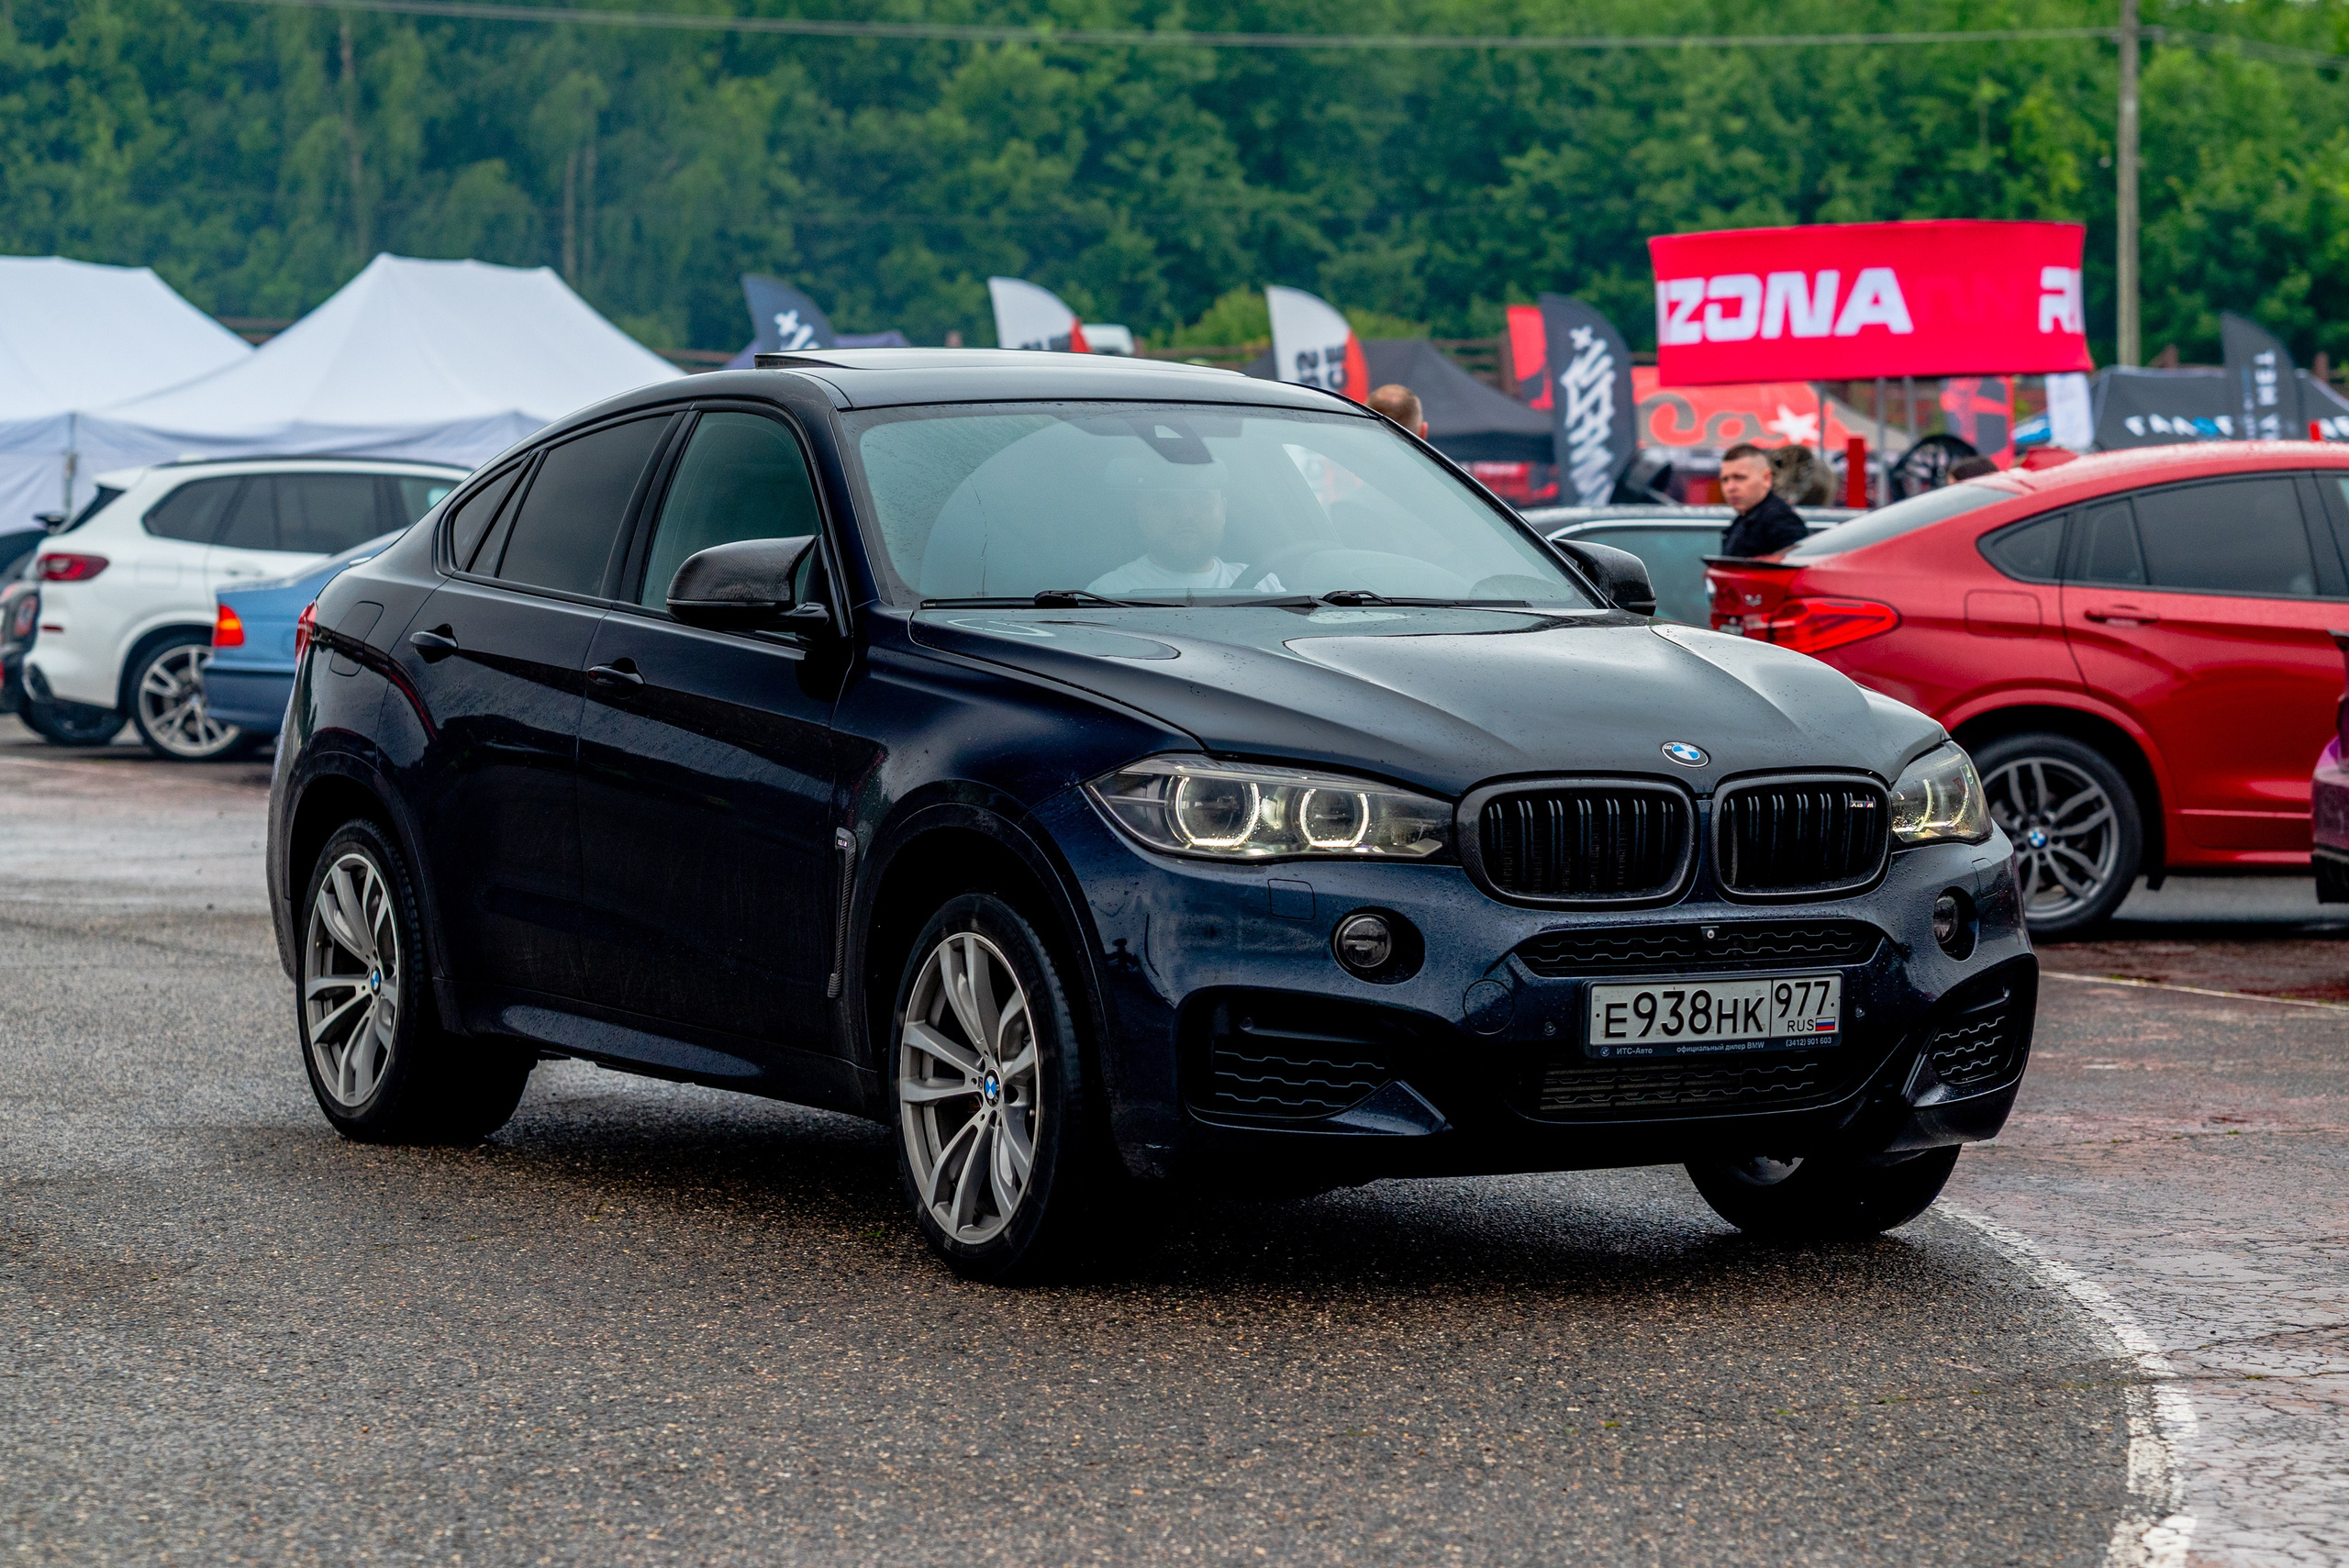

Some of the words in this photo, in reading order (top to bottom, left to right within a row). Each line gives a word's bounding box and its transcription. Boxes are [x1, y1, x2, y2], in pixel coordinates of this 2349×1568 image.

[1656, 267, 1914, 346] ZONA
[1775, 980, 1831, 1018] 977
[1787, 1019, 1815, 1032] RUS
[1676, 1043, 1724, 1053] официальный
[1725, 1043, 1746, 1051] дилер
[1747, 1041, 1765, 1050] BMW
[1786, 1039, 1806, 1047] (3412)
[1807, 1038, 1819, 1046] 901
[1820, 1037, 1832, 1045] 603
[1616, 1046, 1653, 1055] ИТС-Авто
